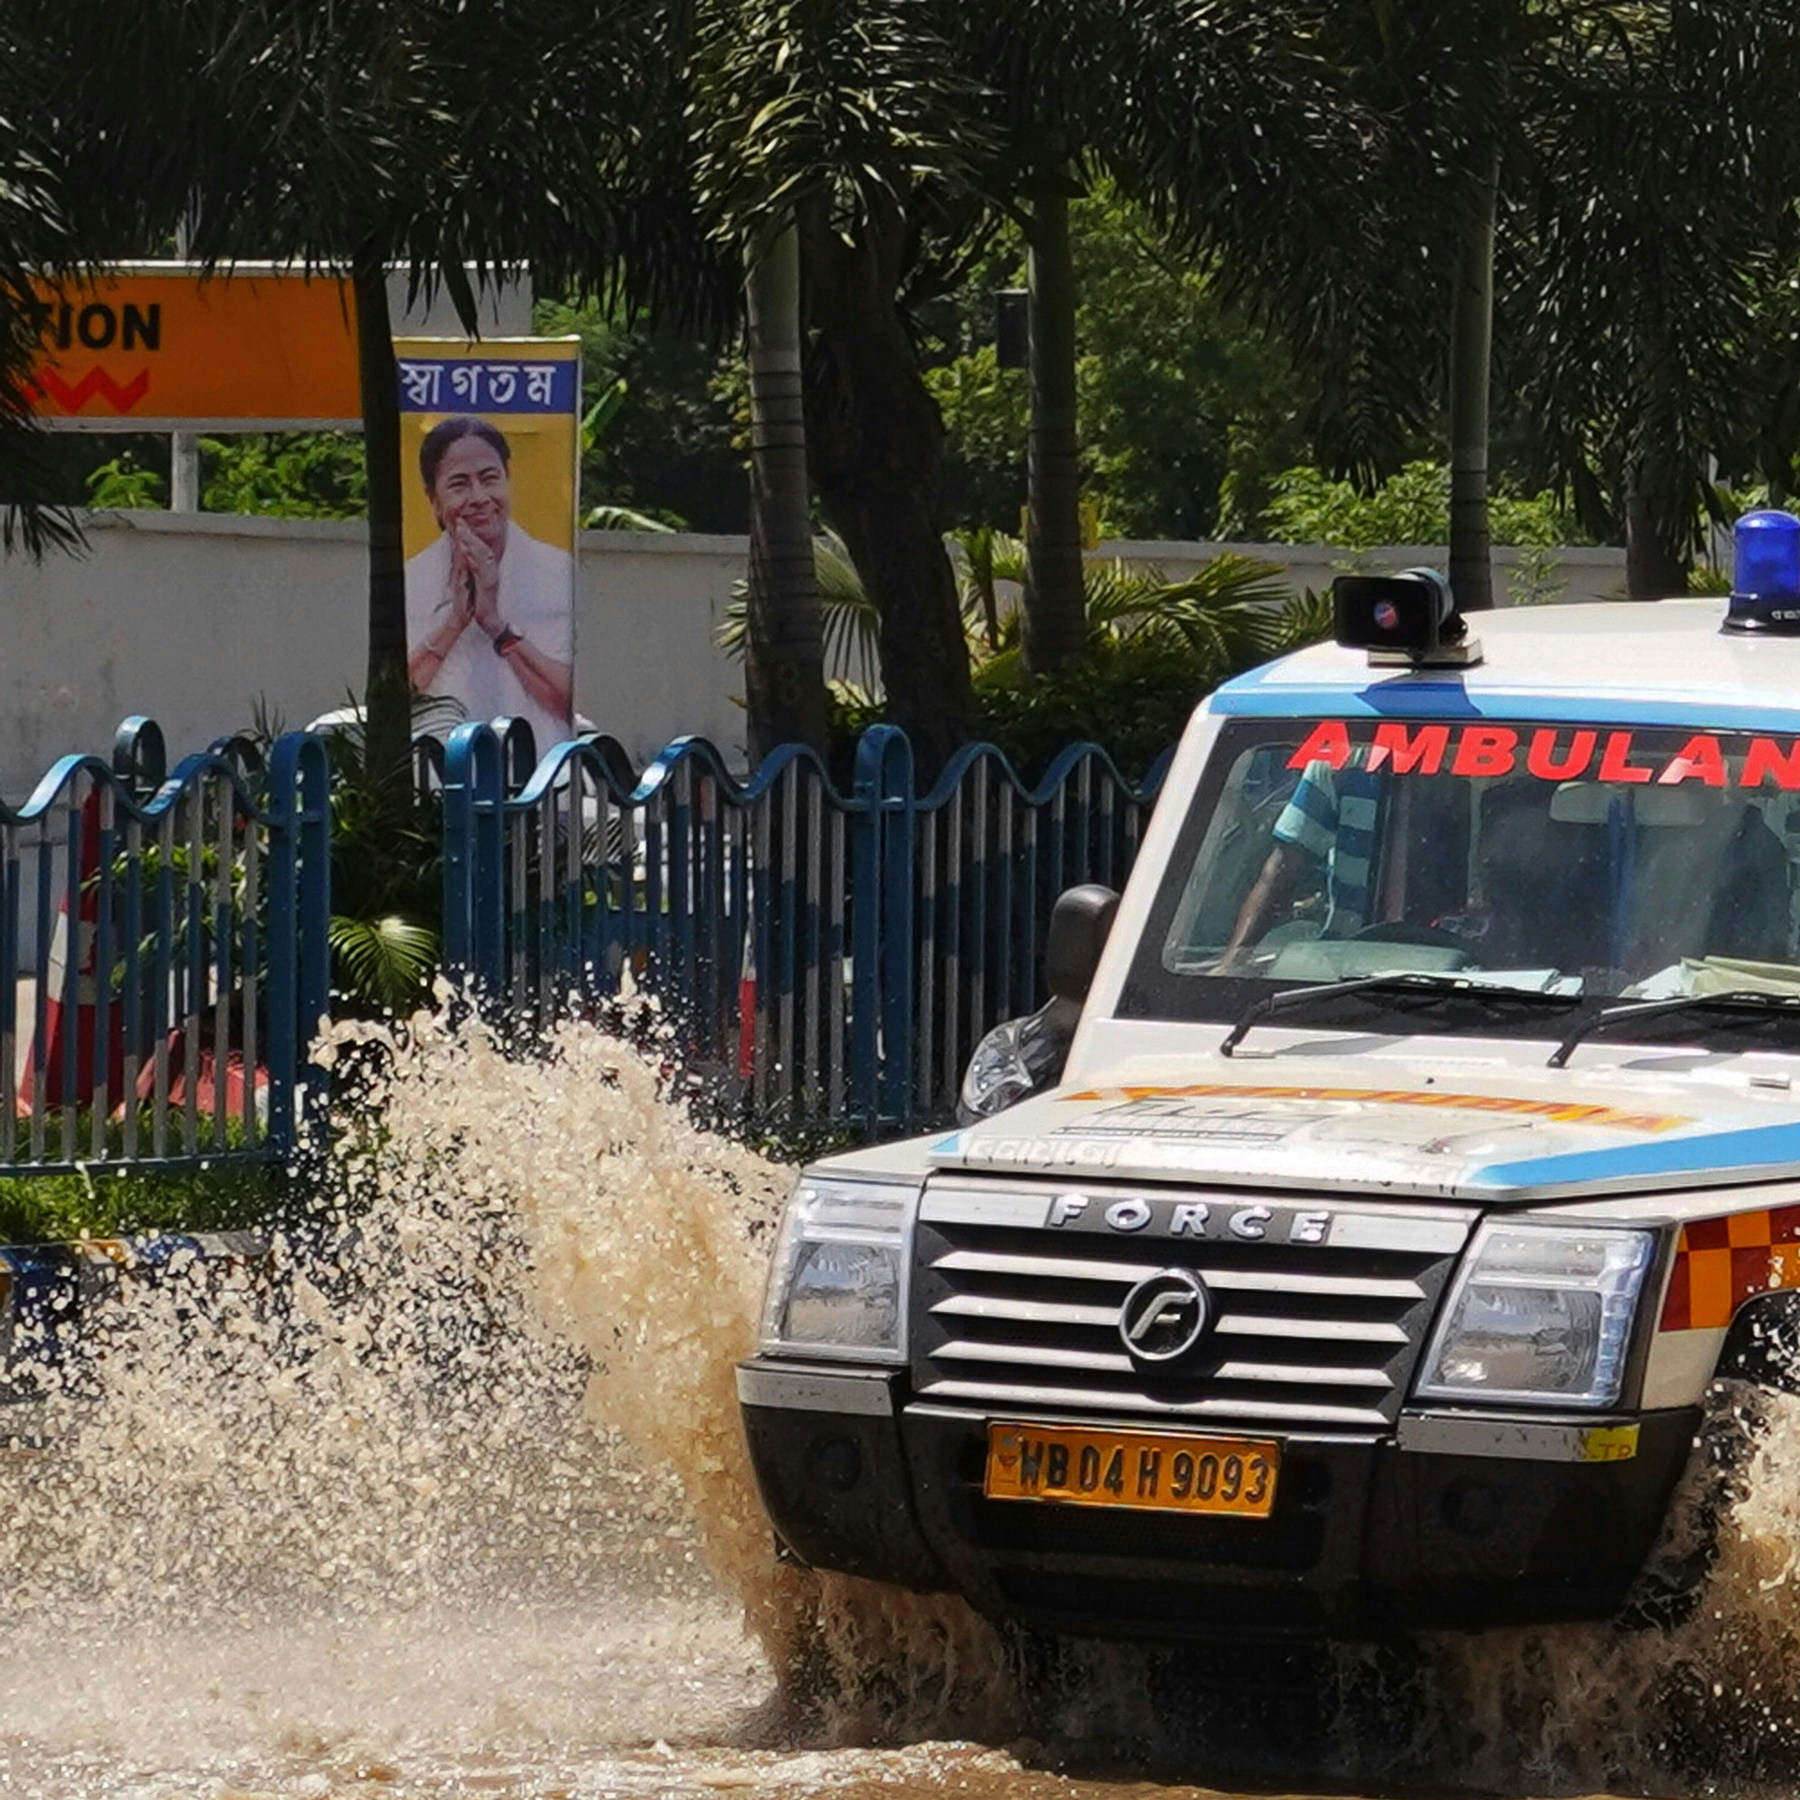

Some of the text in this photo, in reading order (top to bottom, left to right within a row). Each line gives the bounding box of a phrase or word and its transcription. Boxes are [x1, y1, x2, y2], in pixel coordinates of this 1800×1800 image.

[1051, 1194, 1330, 1244] FORCE
[1079, 1445, 1124, 1496] 04
[1136, 1448, 1161, 1499] H
[1172, 1451, 1269, 1503] 9093
